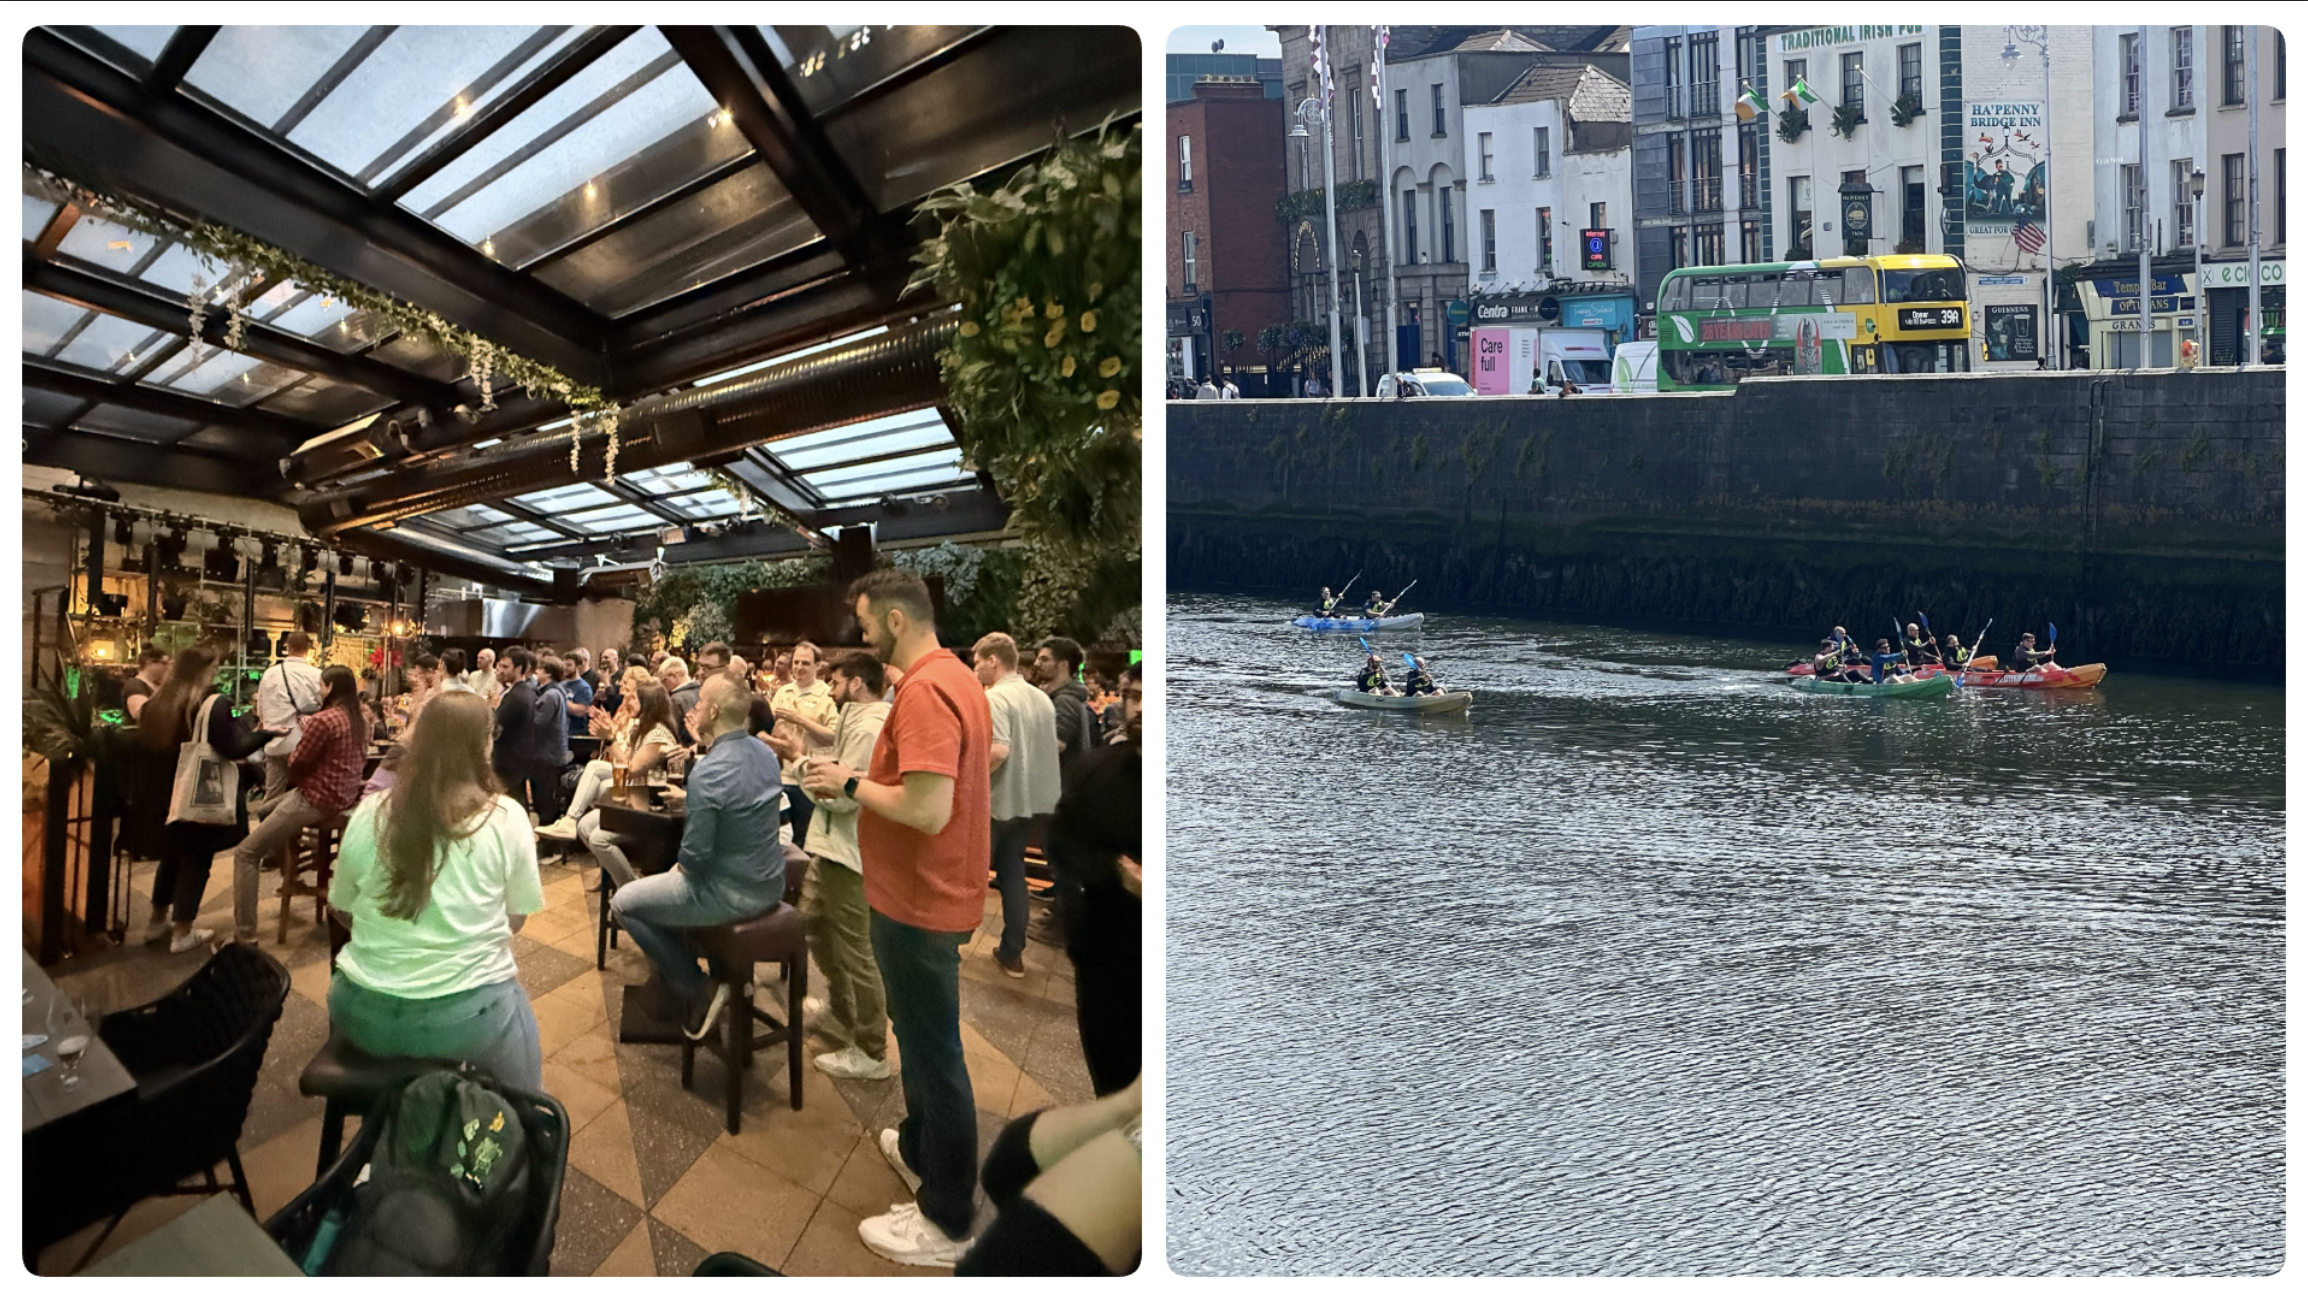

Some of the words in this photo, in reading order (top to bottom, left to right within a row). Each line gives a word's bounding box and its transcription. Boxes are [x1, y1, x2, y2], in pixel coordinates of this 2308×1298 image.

[1781, 25, 1855, 51] TRADITIONAL
[1859, 25, 1893, 41] IRISH
[1971, 104, 2040, 115] HA'PENNY
[1970, 117, 2017, 127] BRIDGE
[2019, 117, 2041, 127] INN
[1969, 225, 1992, 234] GREAT
[1994, 225, 2009, 234] FOR
[2113, 281, 2141, 295] Temp
[2150, 279, 2167, 291] Bar
[1477, 304, 1509, 319] Centra
[1511, 305, 1528, 314] FRANK
[1991, 306, 2029, 314] GUINNESS
[1191, 315, 1202, 327] 50
[1940, 309, 1959, 325] 39A
[1702, 324, 1714, 341] 28
[1714, 322, 1744, 340] YEARS
[1744, 321, 1771, 339] LATER
[2112, 320, 2156, 330] GRANS
[1480, 337, 1503, 354] Care
[1480, 355, 1496, 372] full
